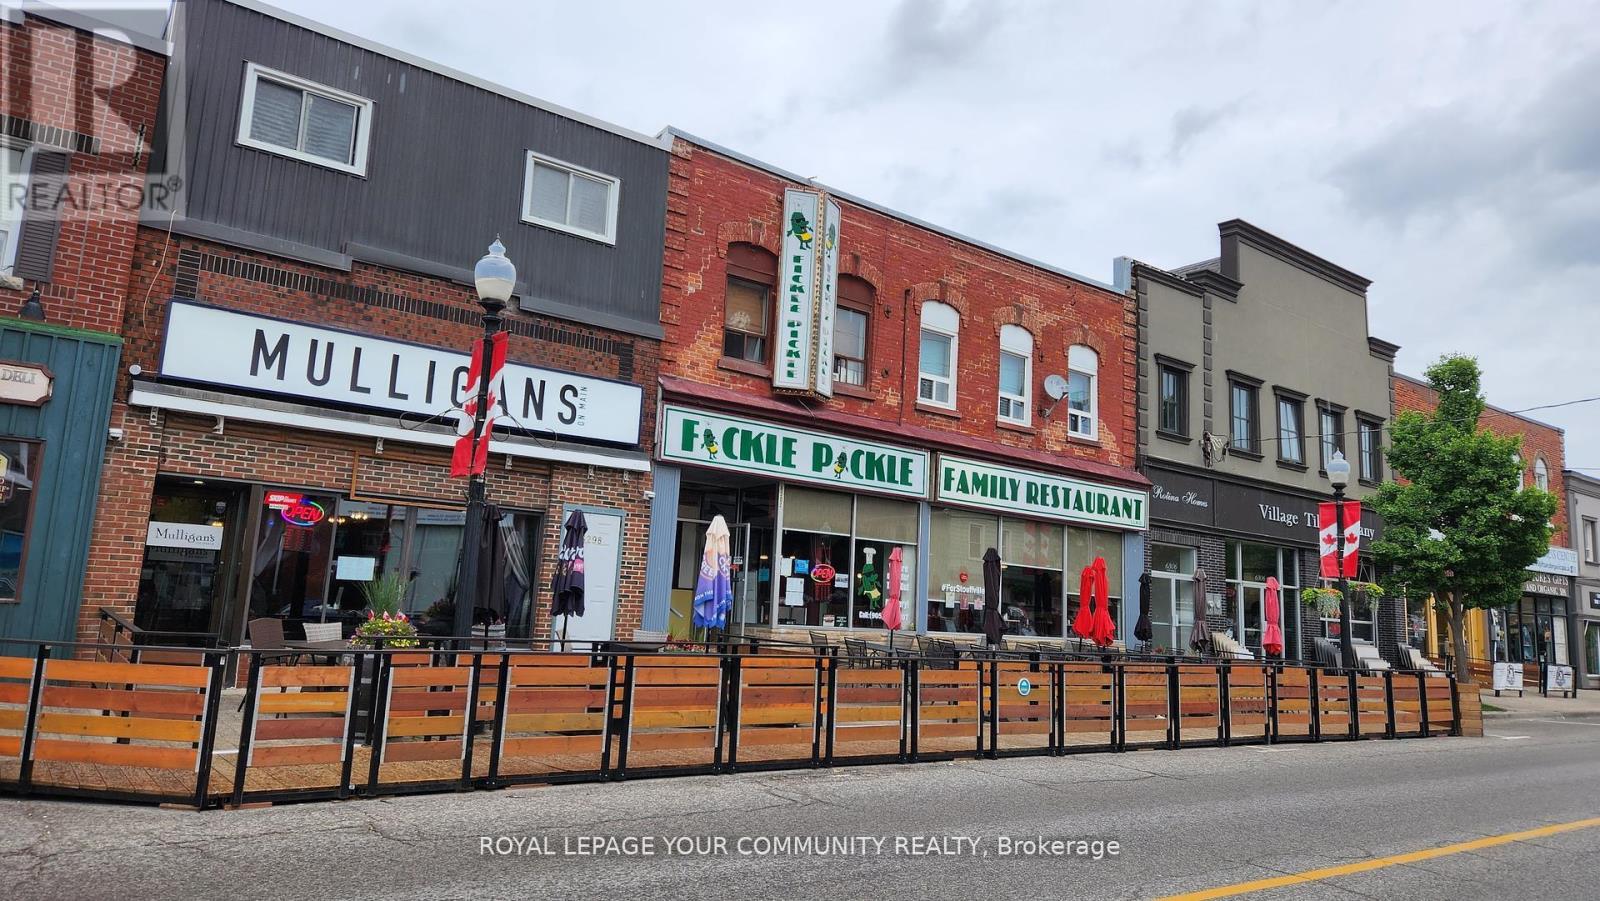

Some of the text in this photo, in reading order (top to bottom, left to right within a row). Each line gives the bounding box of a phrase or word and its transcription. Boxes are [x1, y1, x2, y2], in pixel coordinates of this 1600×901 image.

[1, 368, 36, 384] DELI
[579, 386, 588, 410] MAIN
[943, 467, 1143, 520] FAMILY RESTAURANT
[285, 505, 322, 521] OPEN
[1259, 504, 1299, 527] Village
[1304, 512, 1320, 528] Til
[155, 527, 216, 544] Mulligan's
[813, 567, 833, 579] OPEN
[1552, 575, 1569, 586] GIFTS
[1526, 583, 1537, 592] AND
[1537, 585, 1558, 595] ORGANIC
